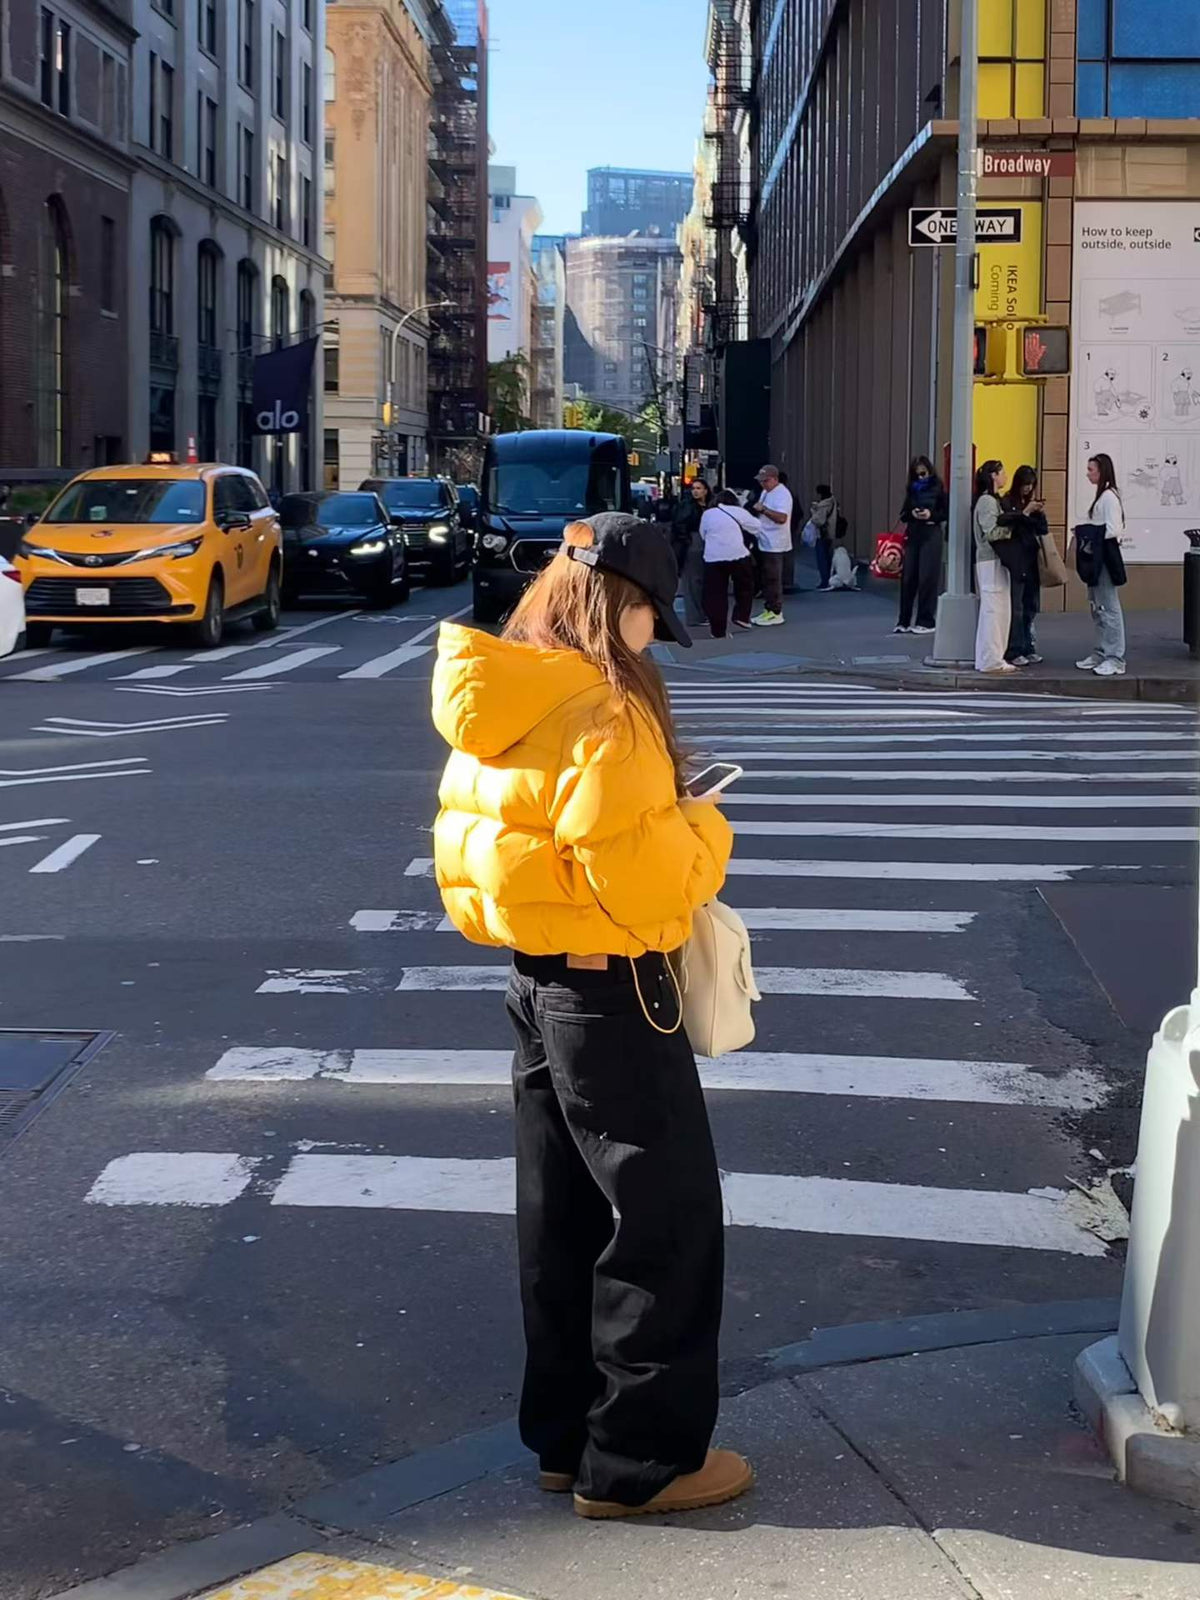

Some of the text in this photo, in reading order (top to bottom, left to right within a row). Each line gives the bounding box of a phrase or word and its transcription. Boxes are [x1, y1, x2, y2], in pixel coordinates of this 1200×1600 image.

[984, 154, 1051, 177] Broadway
[927, 218, 1007, 234] ONE WAY
[1081, 226, 1153, 239] How to keep
[1081, 239, 1172, 251] outside, outside
[1006, 265, 1018, 294] IKEA
[987, 264, 1002, 311] Coming
[1086, 352, 1091, 361] 1
[1162, 352, 1169, 361] 2
[256, 399, 299, 430] alo
[1084, 441, 1090, 450] 3
